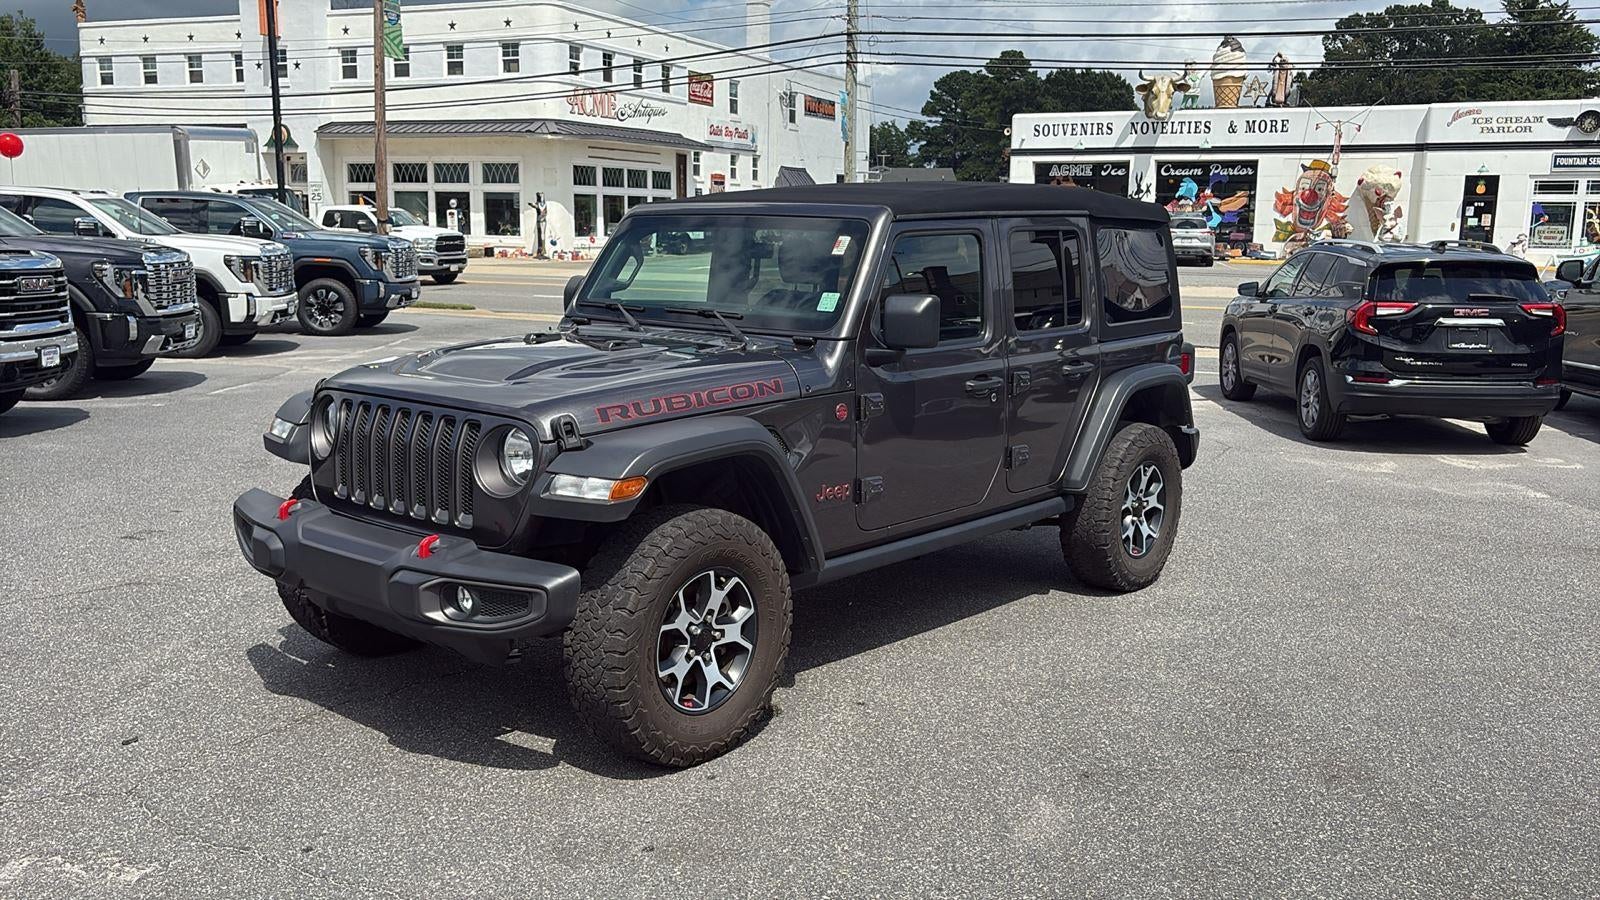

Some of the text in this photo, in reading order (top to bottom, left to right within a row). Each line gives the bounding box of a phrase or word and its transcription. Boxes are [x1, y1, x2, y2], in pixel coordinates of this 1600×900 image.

[567, 87, 617, 119] ACME
[629, 97, 668, 124] Antiques
[1496, 116, 1544, 124] CREAM
[1033, 119, 1290, 137] SOUVENIRS NOVELTIES & MORE
[1556, 157, 1588, 165] FOUNTAIN
[1049, 164, 1127, 177] ACME Ice
[1160, 163, 1254, 176] Cream Parlor
[311, 192, 322, 201] 25
[1454, 308, 1490, 316] GMC
[595, 378, 783, 423] RUBICON
[816, 483, 850, 502] Jeep
